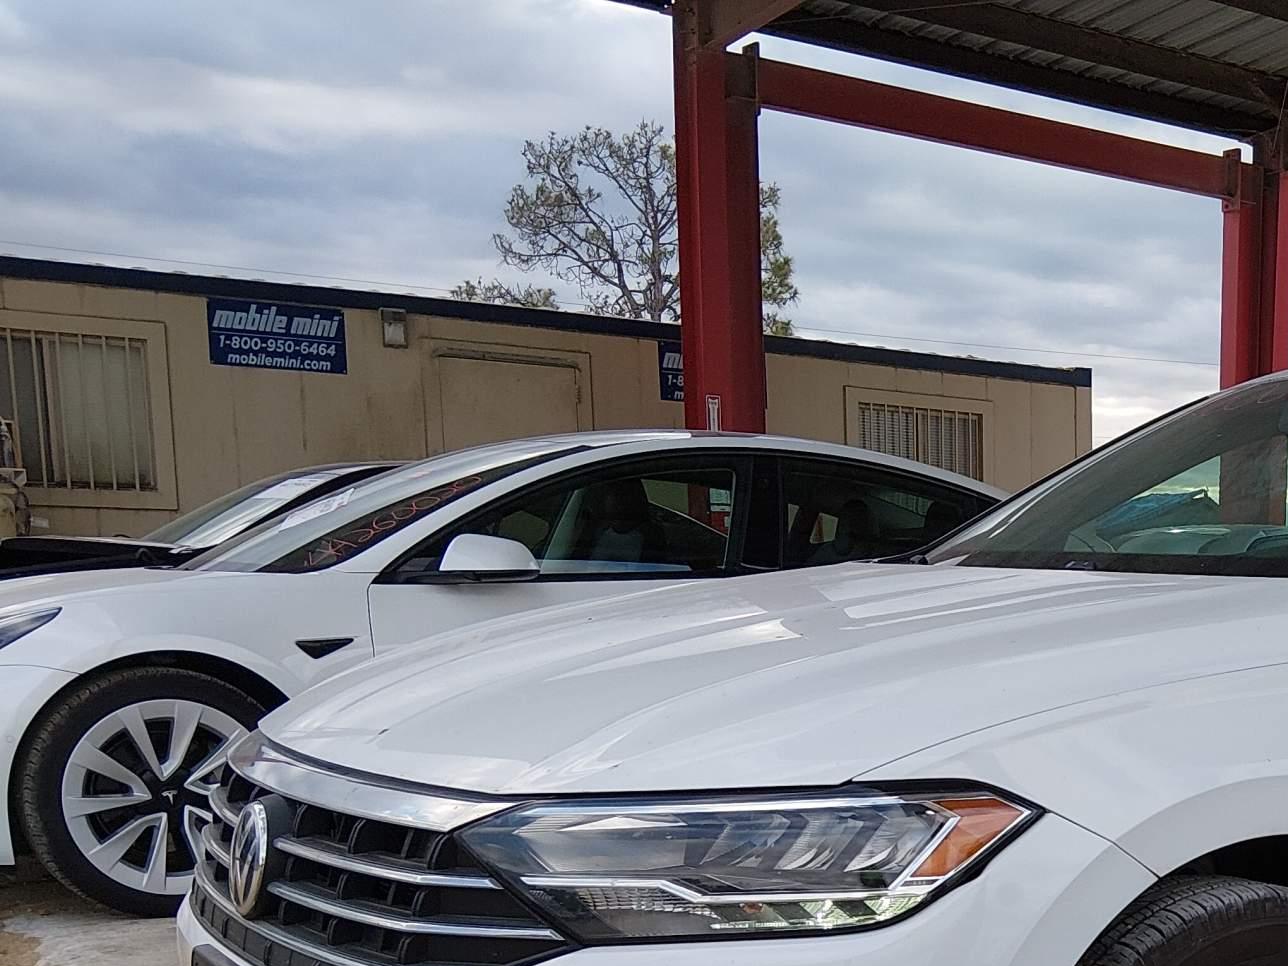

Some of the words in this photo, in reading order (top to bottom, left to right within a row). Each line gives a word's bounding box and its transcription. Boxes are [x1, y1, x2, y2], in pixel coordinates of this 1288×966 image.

[212, 304, 288, 333] mobile
[290, 314, 342, 338] mini
[219, 335, 336, 356] 1-800-950-6464
[227, 353, 331, 371] mobilemini.com
